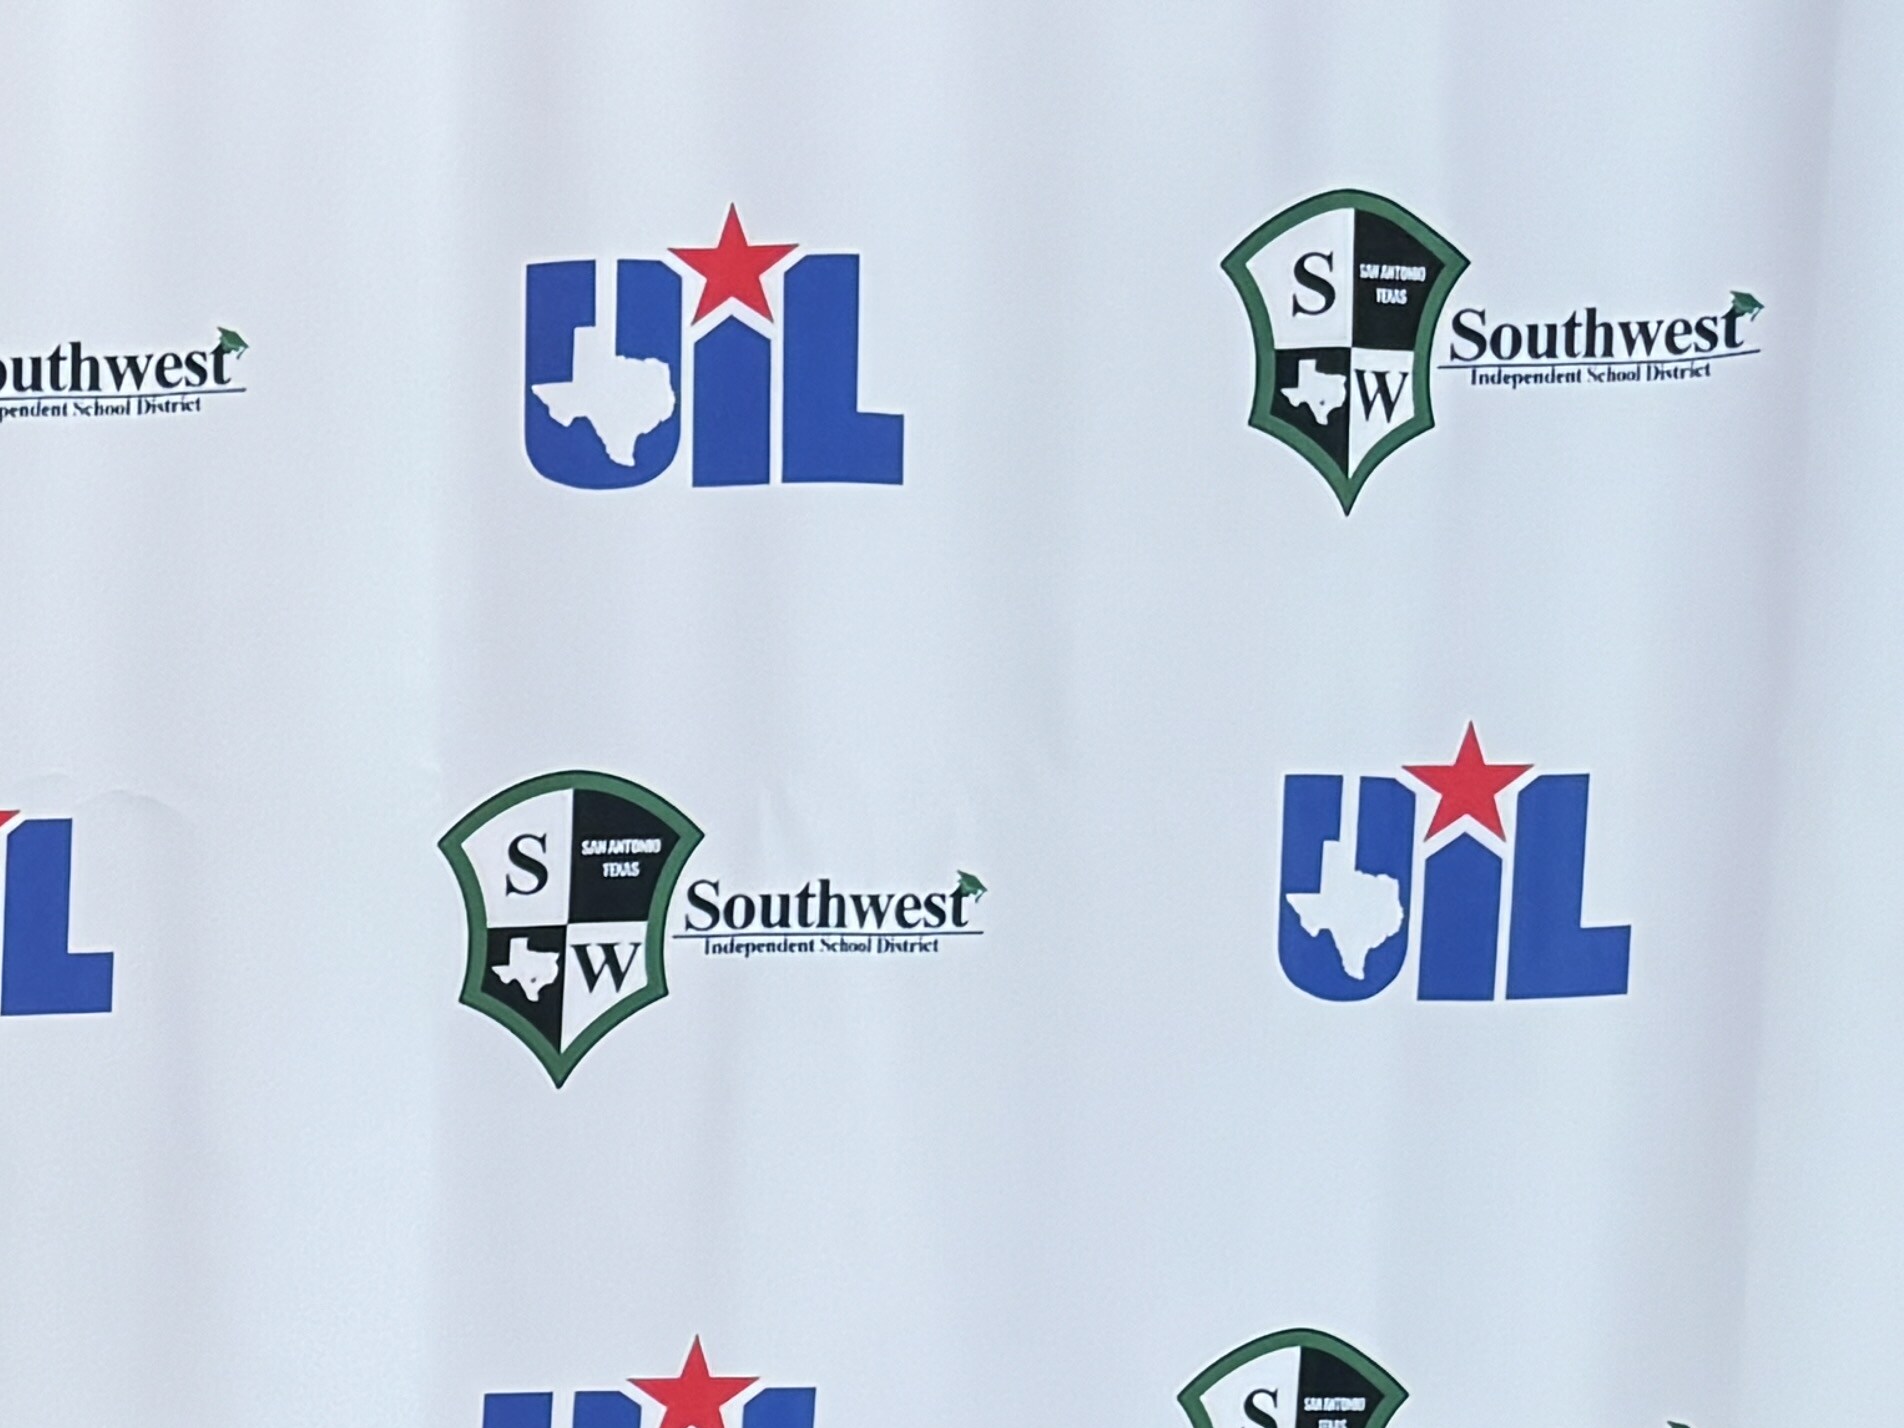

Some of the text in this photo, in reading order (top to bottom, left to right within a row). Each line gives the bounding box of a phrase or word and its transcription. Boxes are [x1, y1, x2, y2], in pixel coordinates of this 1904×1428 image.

[1292, 252, 1336, 316] S
[1450, 290, 1744, 362] Southwest
[1355, 368, 1408, 422] W
[505, 833, 549, 896] S
[684, 869, 970, 932] Southwest
[571, 942, 640, 993] W
